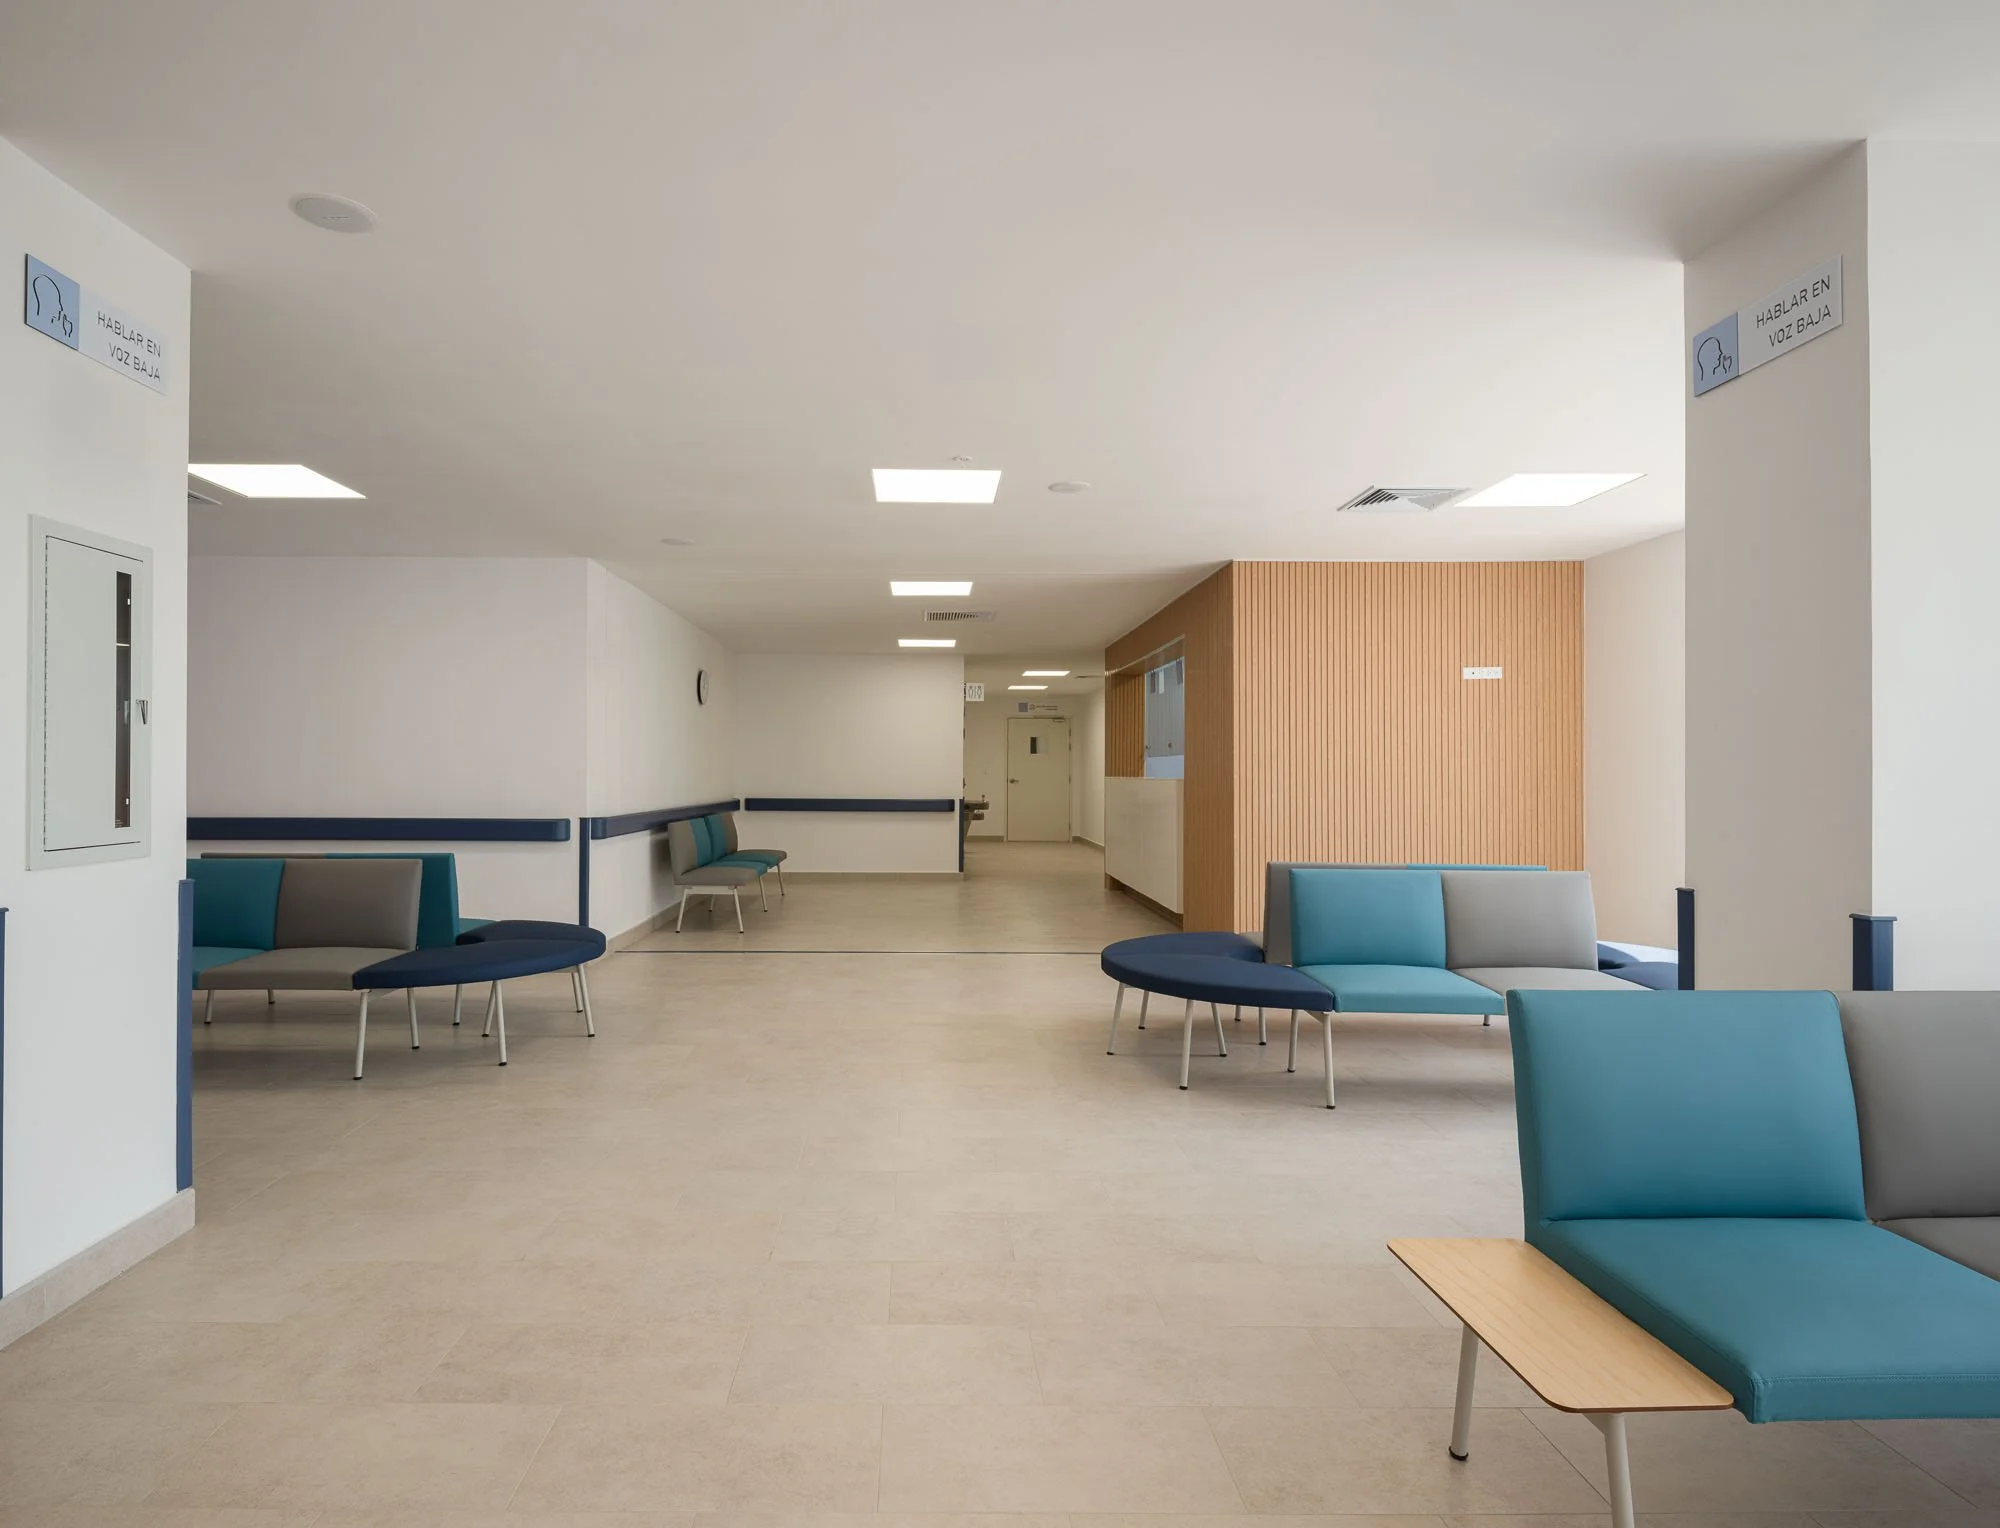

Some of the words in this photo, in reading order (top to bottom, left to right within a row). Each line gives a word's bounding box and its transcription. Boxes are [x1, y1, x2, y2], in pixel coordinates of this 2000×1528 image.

[1756, 288, 1808, 329] HABLAR
[1812, 274, 1830, 298] EN
[97, 310, 143, 349] HABLAR
[146, 338, 161, 358] EN
[1768, 323, 1793, 347] VOZ
[1796, 304, 1832, 334] BAJA
[108, 342, 131, 366] VOZ
[133, 356, 161, 382] BAJA
